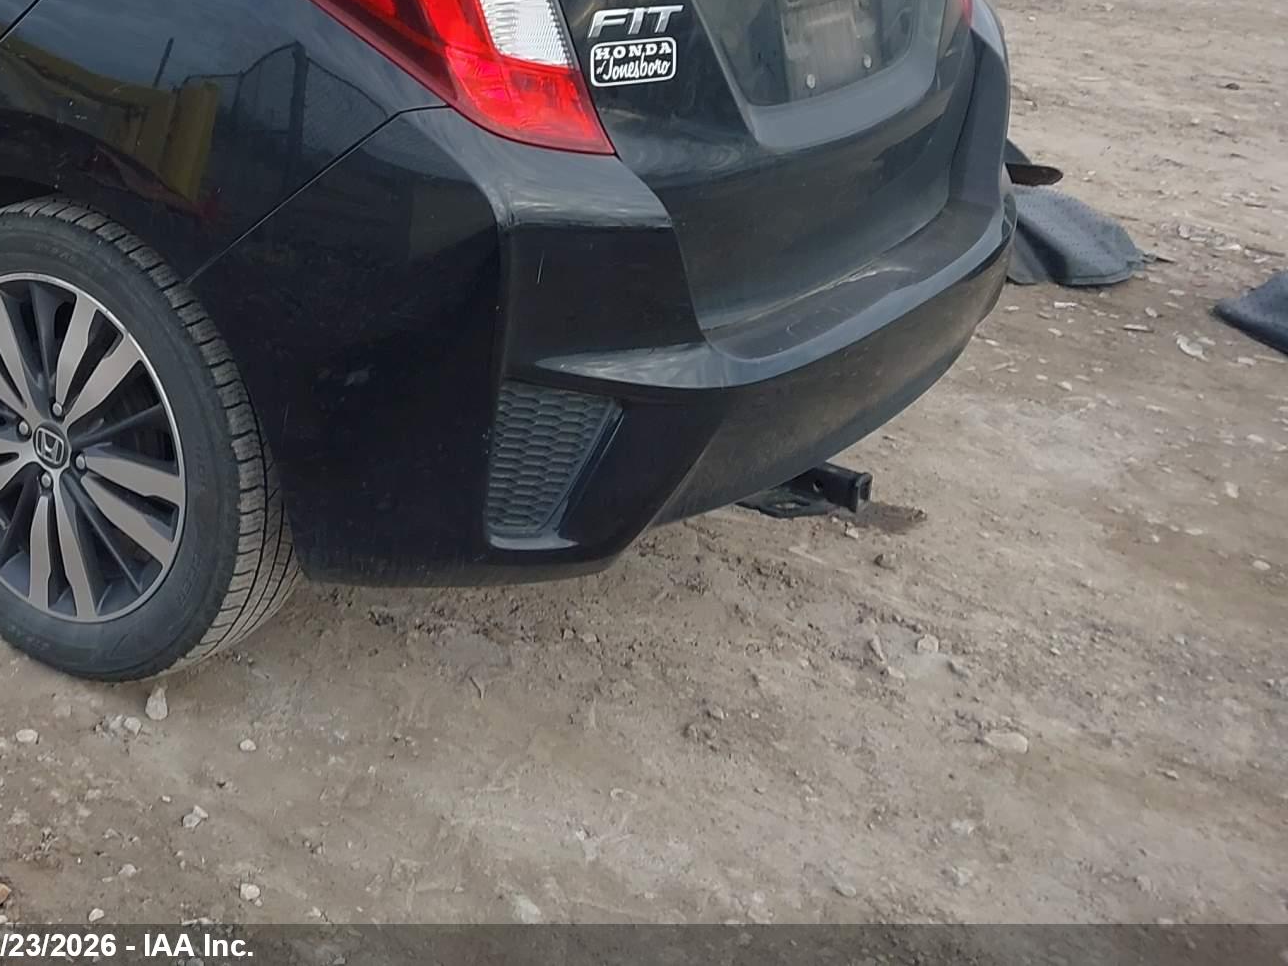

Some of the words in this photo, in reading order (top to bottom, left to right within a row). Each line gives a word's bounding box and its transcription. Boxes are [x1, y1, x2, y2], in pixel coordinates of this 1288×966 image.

[588, 5, 684, 39] FIT
[595, 42, 672, 60] HONDA
[602, 52, 671, 80] Jonesboro
